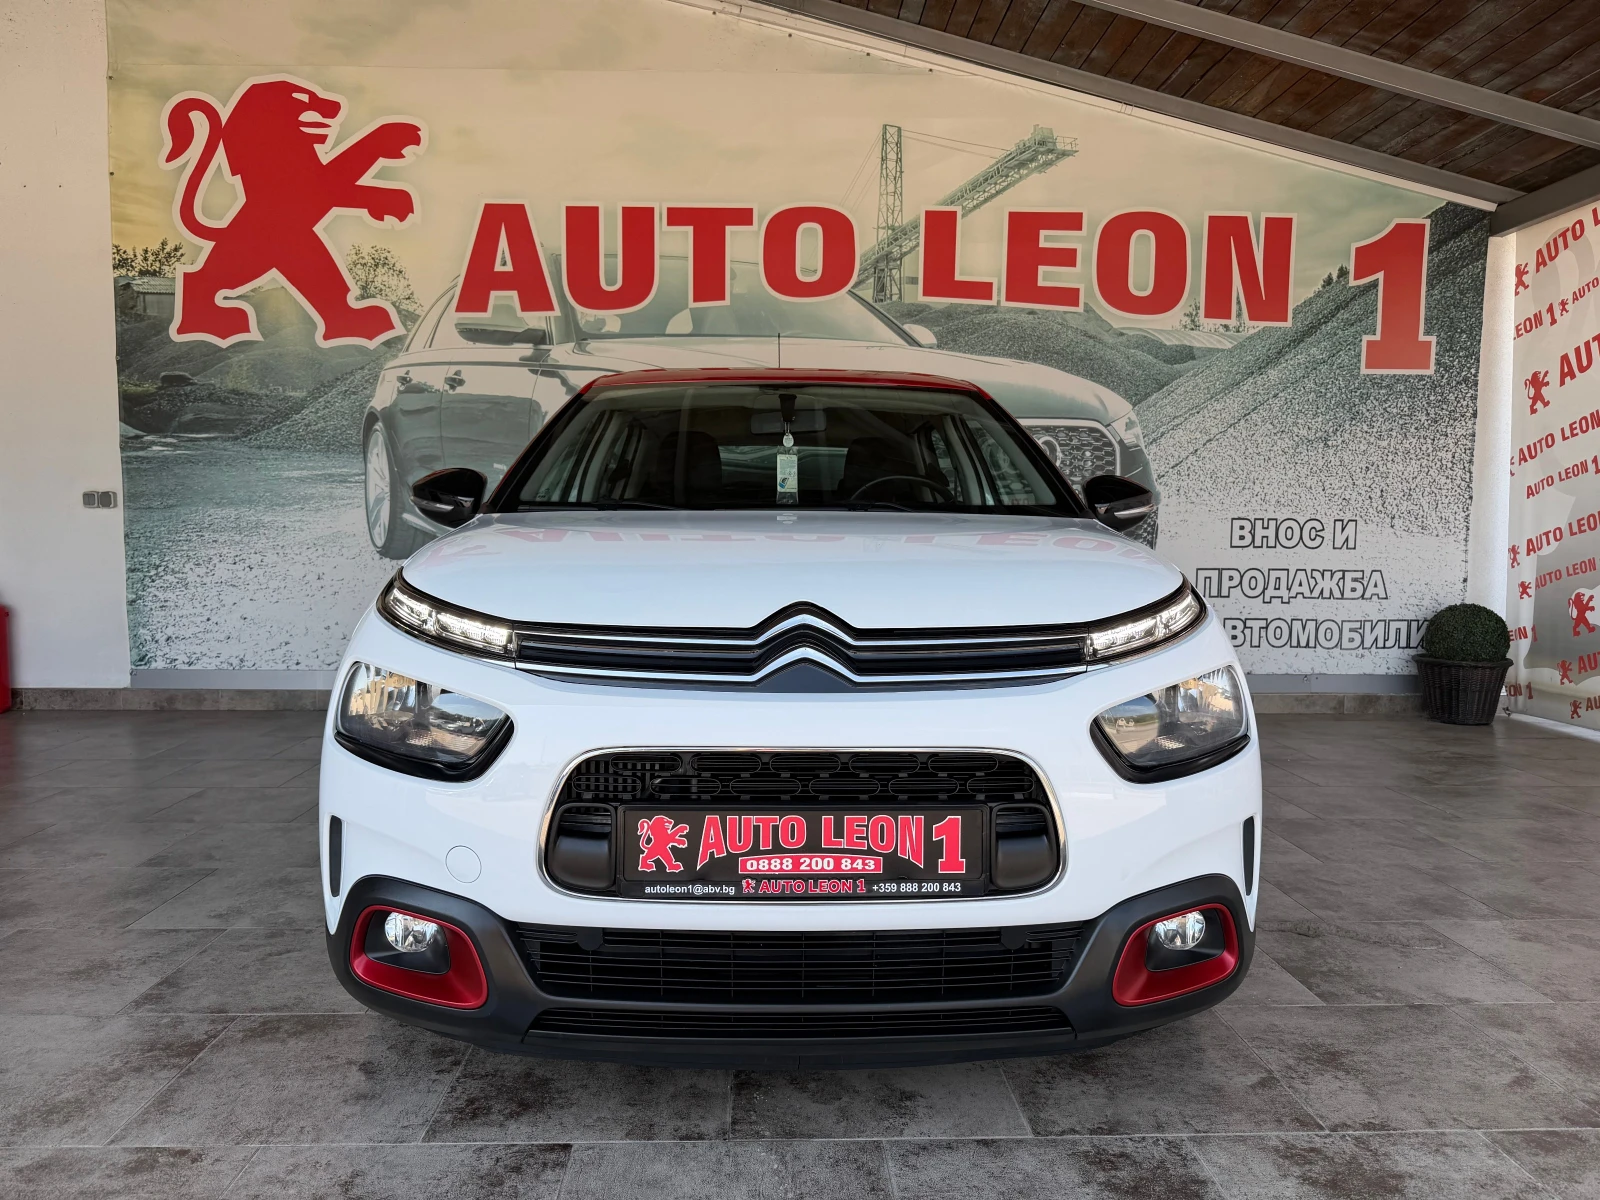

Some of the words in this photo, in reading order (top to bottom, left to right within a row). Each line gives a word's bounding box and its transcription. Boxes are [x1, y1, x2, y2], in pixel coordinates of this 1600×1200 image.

[1536, 219, 1585, 274] AUTO
[453, 201, 861, 316] AUTO
[918, 206, 1297, 327] LEON
[1349, 218, 1435, 374] 1
[1572, 277, 1600, 304] AUTO
[1514, 309, 1544, 340] EON
[1546, 302, 1558, 327] 1
[1518, 433, 1556, 466] AUTO
[1560, 409, 1600, 441] LEON
[1527, 475, 1555, 499] AUTO
[1558, 459, 1589, 482] LEON
[1592, 455, 1600, 475] 1
[1230, 518, 1325, 549] ВНОС
[1333, 519, 1357, 549] И
[1526, 526, 1564, 556] AUTO
[1568, 510, 1600, 537] LEO
[1196, 568, 1388, 604] ПРОДАЖБА
[1535, 569, 1562, 590] AUTO
[1566, 557, 1597, 577] LEON
[1223, 618, 1429, 650] ВТОМОБИЛИ
[1531, 624, 1538, 642] 1
[1578, 651, 1600, 674] AU
[1526, 682, 1533, 699] 1
[697, 815, 807, 871] AUTO
[821, 815, 924, 868] LEON
[932, 815, 966, 873] 1
[746, 858, 793, 871] 0888
[799, 857, 835, 871] 200
[840, 858, 876, 870] 843
[644, 884, 735, 895] autoleon1@abv.bg
[759, 880, 805, 893] AUTO
[808, 880, 853, 893] LEON
[856, 879, 866, 893] 1
[872, 883, 897, 893] +359
[900, 883, 918, 892] 888
[921, 883, 940, 892] 200
[942, 883, 962, 892] 843
